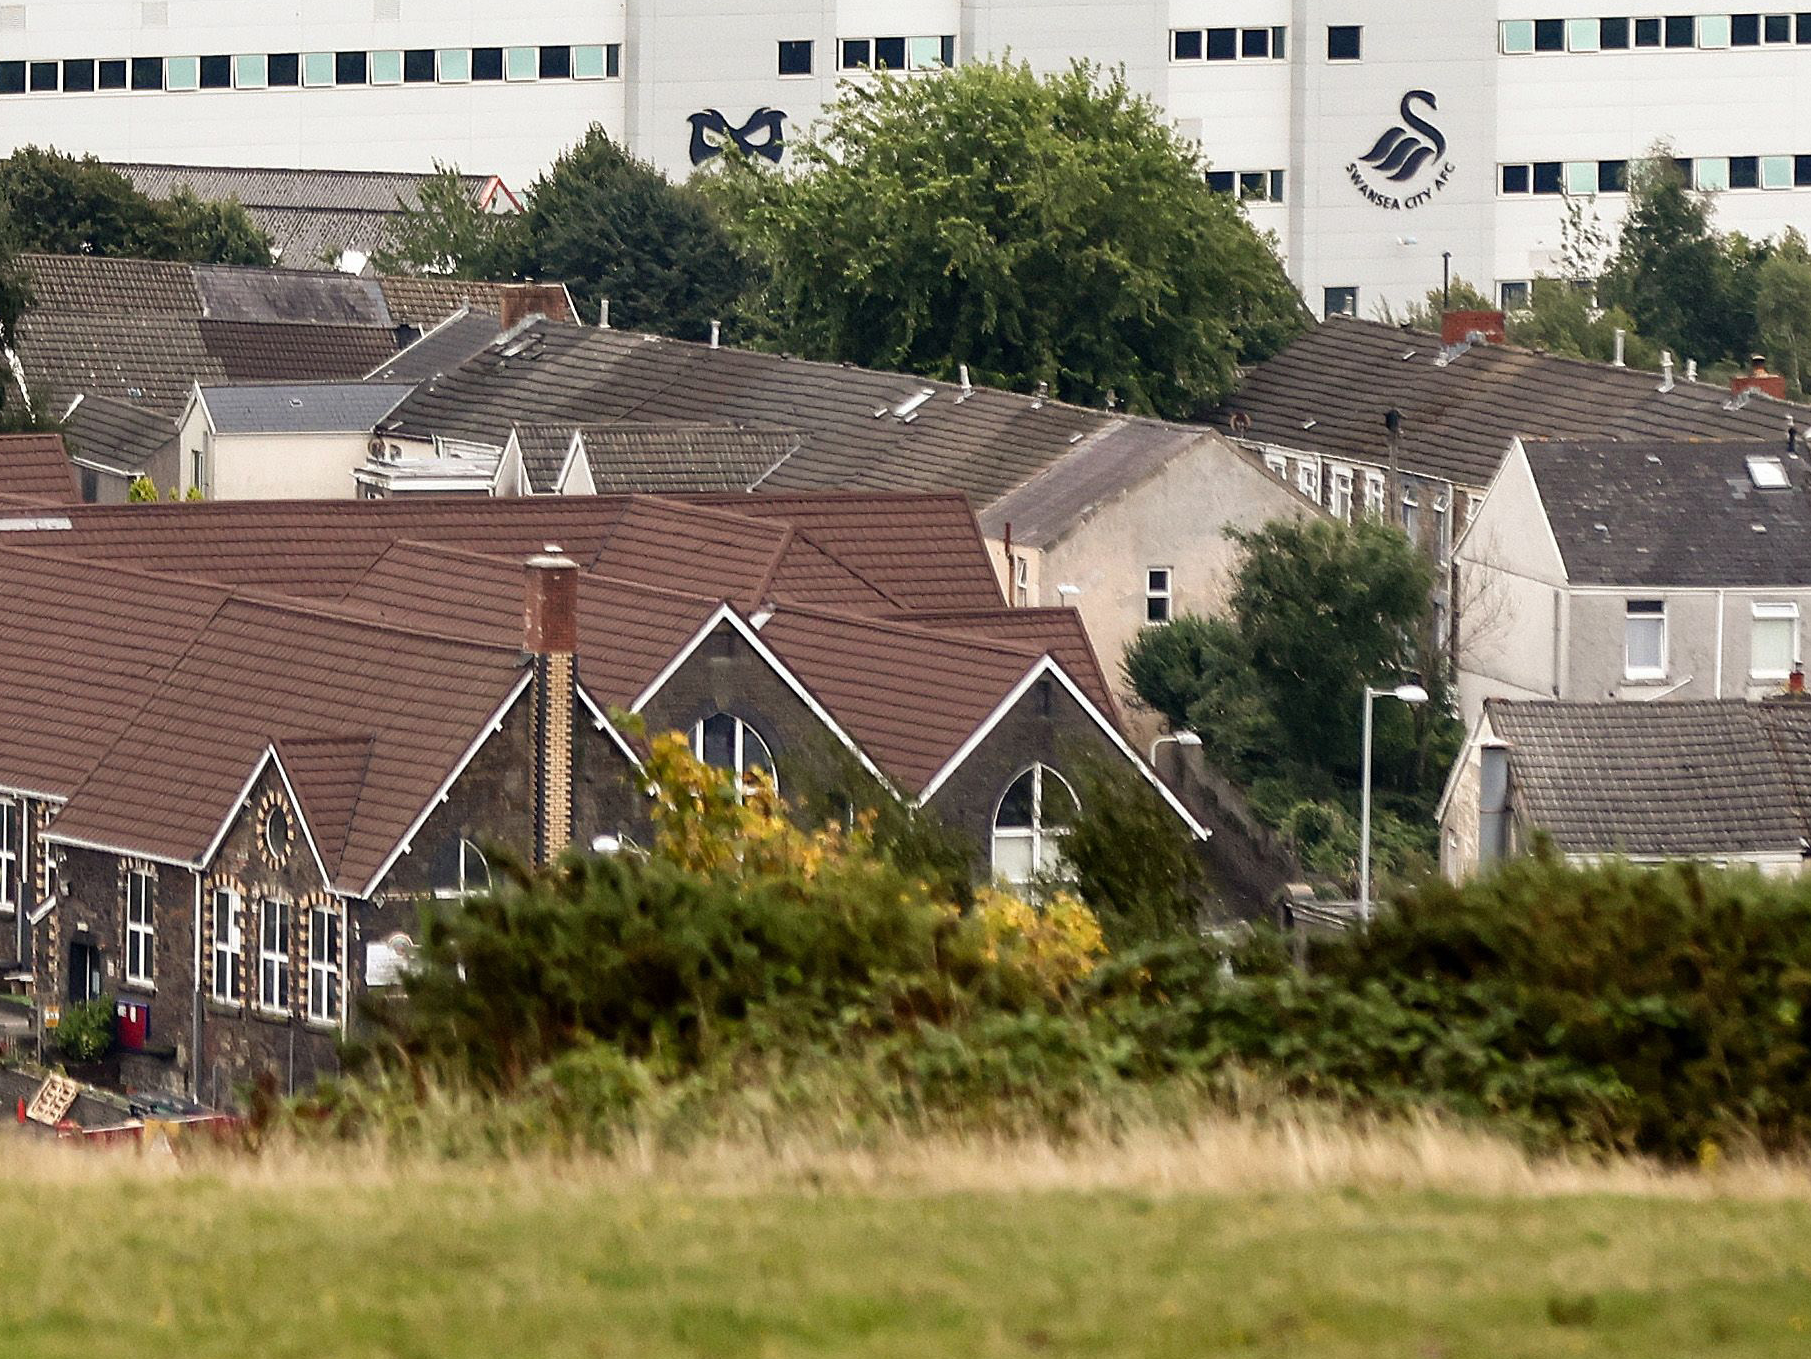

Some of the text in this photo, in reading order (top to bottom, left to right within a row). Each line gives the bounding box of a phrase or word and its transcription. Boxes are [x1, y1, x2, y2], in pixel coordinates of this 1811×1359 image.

[1346, 162, 1456, 210] SWANSEA CITY AFC
